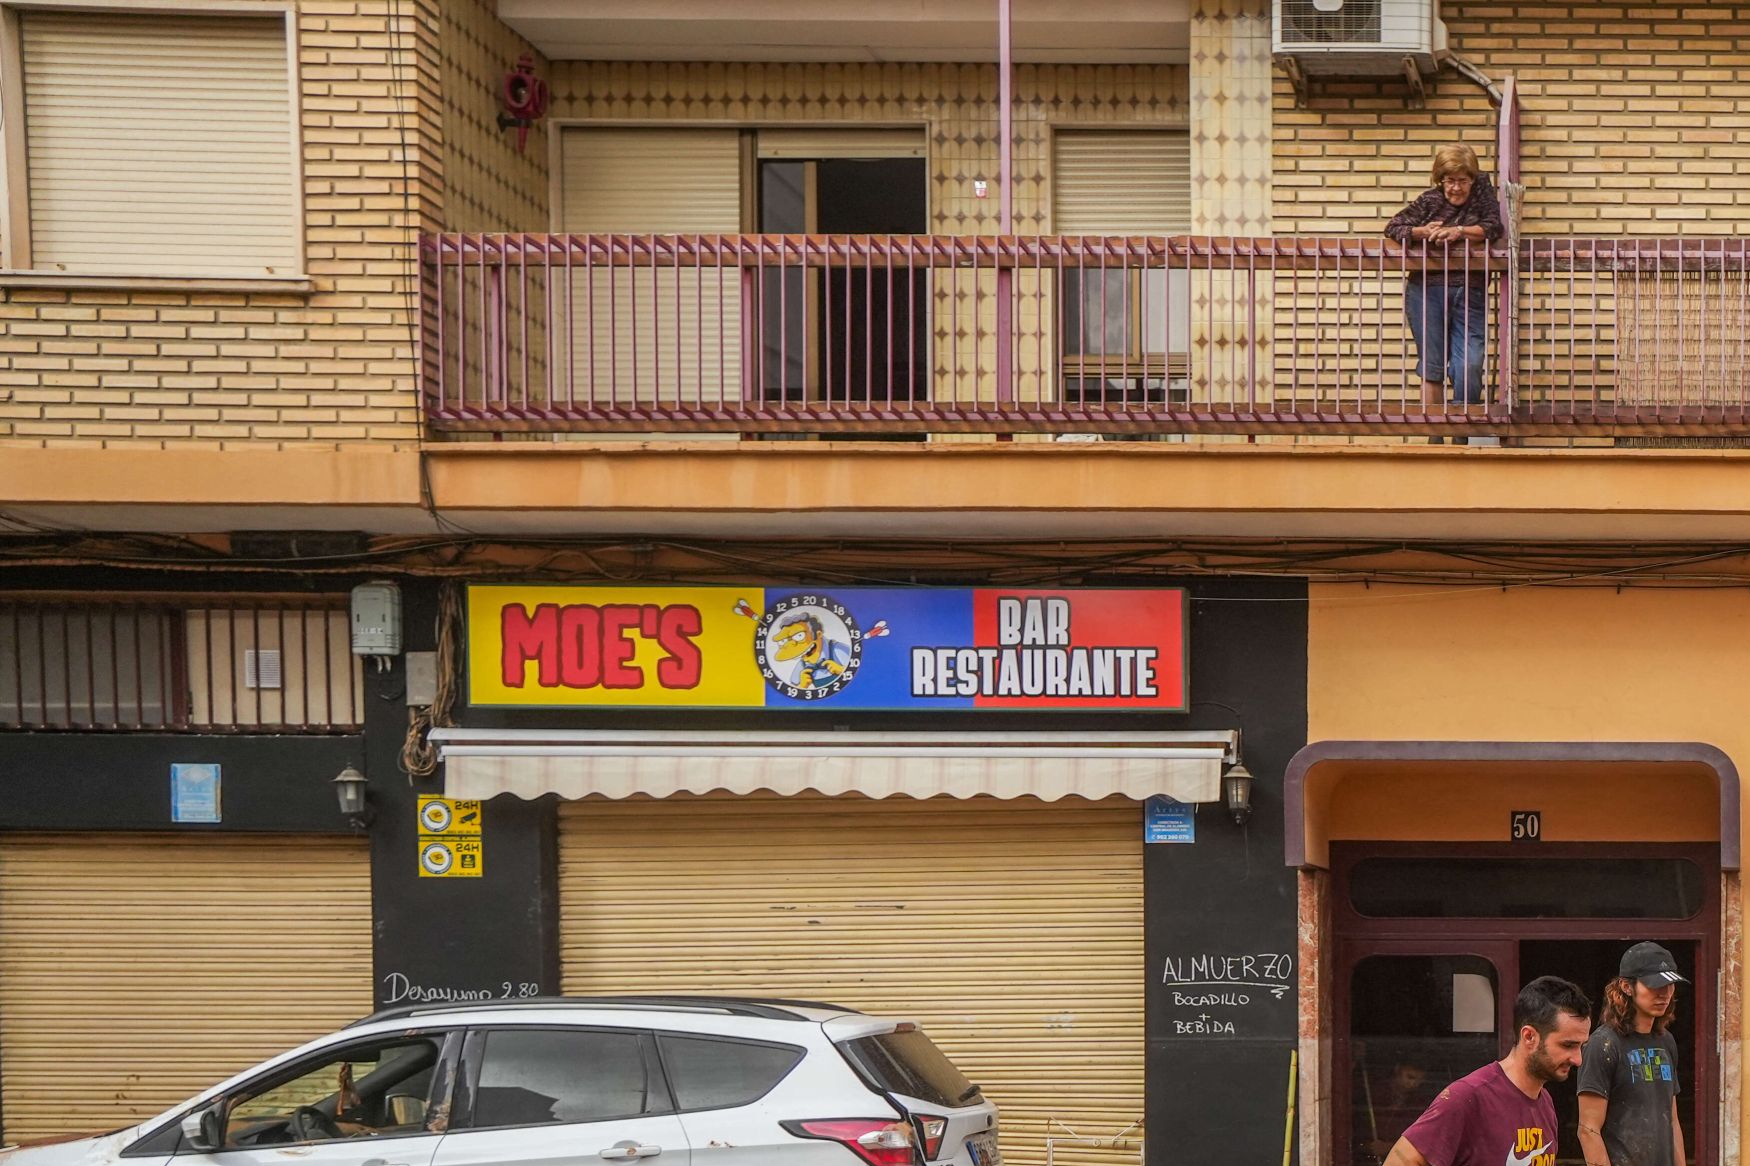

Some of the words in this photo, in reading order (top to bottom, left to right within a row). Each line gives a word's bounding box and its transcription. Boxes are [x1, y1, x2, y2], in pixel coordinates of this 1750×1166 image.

[791, 597, 799, 607] 5
[803, 596, 816, 605] 20
[822, 598, 827, 607] 1
[776, 602, 787, 613] 12
[833, 604, 845, 616] 18
[766, 613, 773, 623] 9
[845, 616, 852, 626] 4
[998, 597, 1071, 648] BAR
[757, 627, 768, 637] 14
[850, 629, 861, 638] 13
[501, 602, 703, 690] MOE'S
[756, 642, 765, 650] 11
[854, 644, 861, 653] 6
[758, 655, 765, 665] 8
[849, 658, 860, 668] 10
[763, 667, 773, 679] 16
[842, 671, 853, 681] 15
[911, 647, 1159, 696] RESTAURANTE
[776, 681, 783, 691] 7
[833, 682, 840, 691] 2
[787, 688, 798, 699] 19
[805, 690, 812, 700] 3
[817, 688, 829, 698] 17
[455, 800, 479, 809] 24H
[1512, 813, 1539, 838] 50
[456, 843, 480, 852] 24H
[1163, 953, 1293, 983] ALMUERZO
[1172, 992, 1250, 1006] BOCADILLO
[1515, 1127, 1543, 1153] JUST
